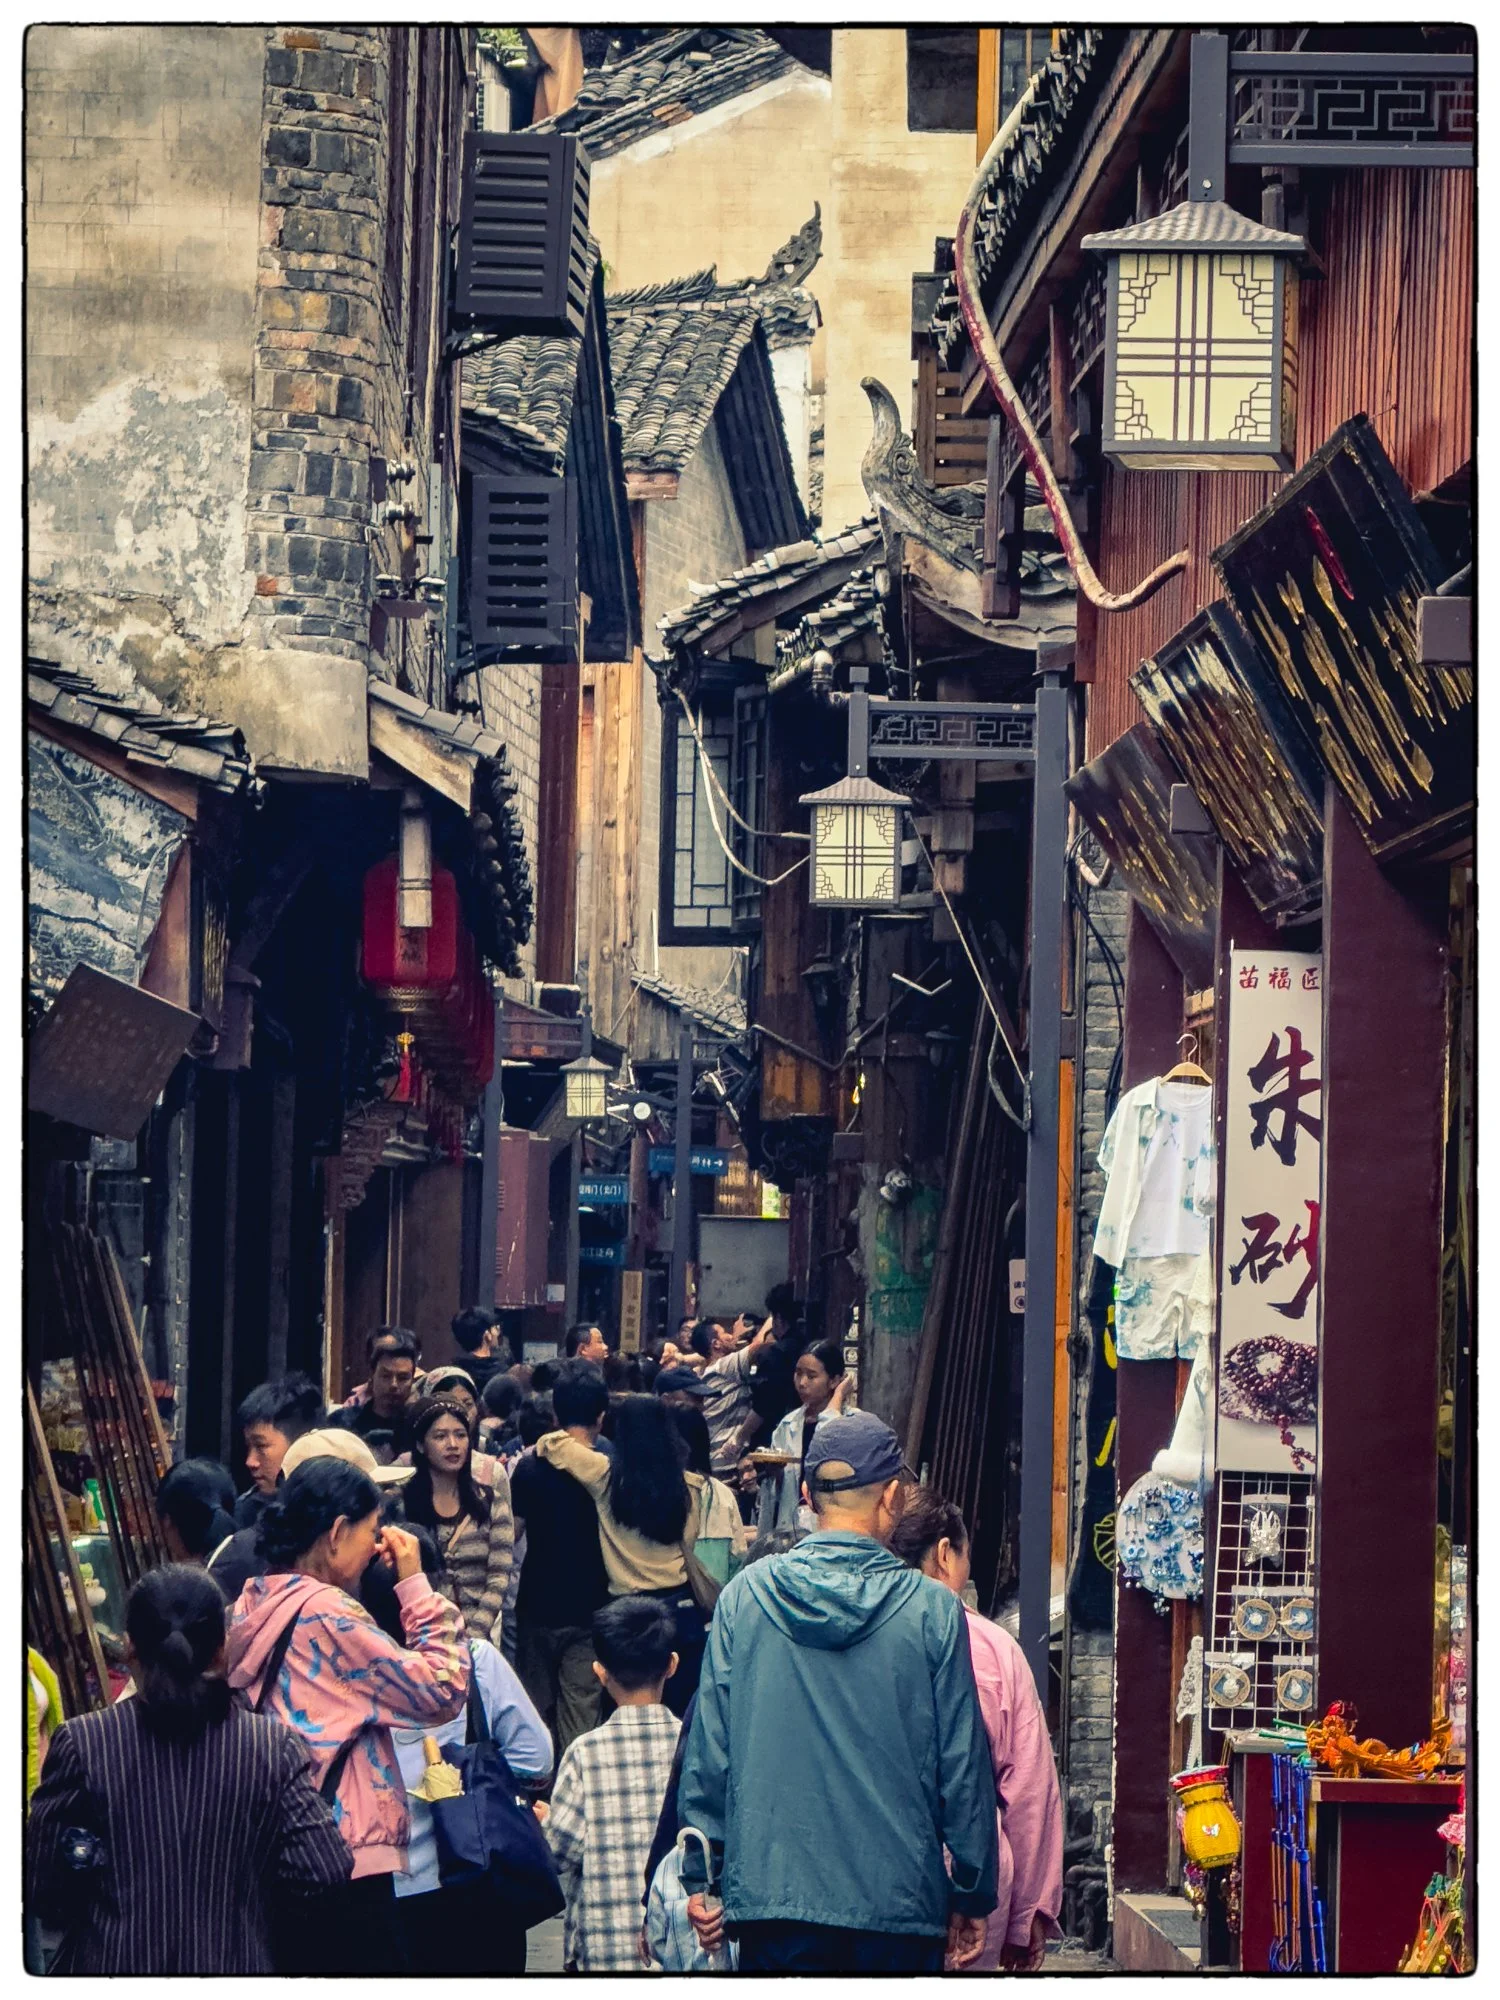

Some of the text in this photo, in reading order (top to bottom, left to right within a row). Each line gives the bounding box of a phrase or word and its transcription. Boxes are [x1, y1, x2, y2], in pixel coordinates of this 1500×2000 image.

[1239, 964, 1321, 990] 苗福匠
[1229, 1025, 1322, 1319] 朱砂
